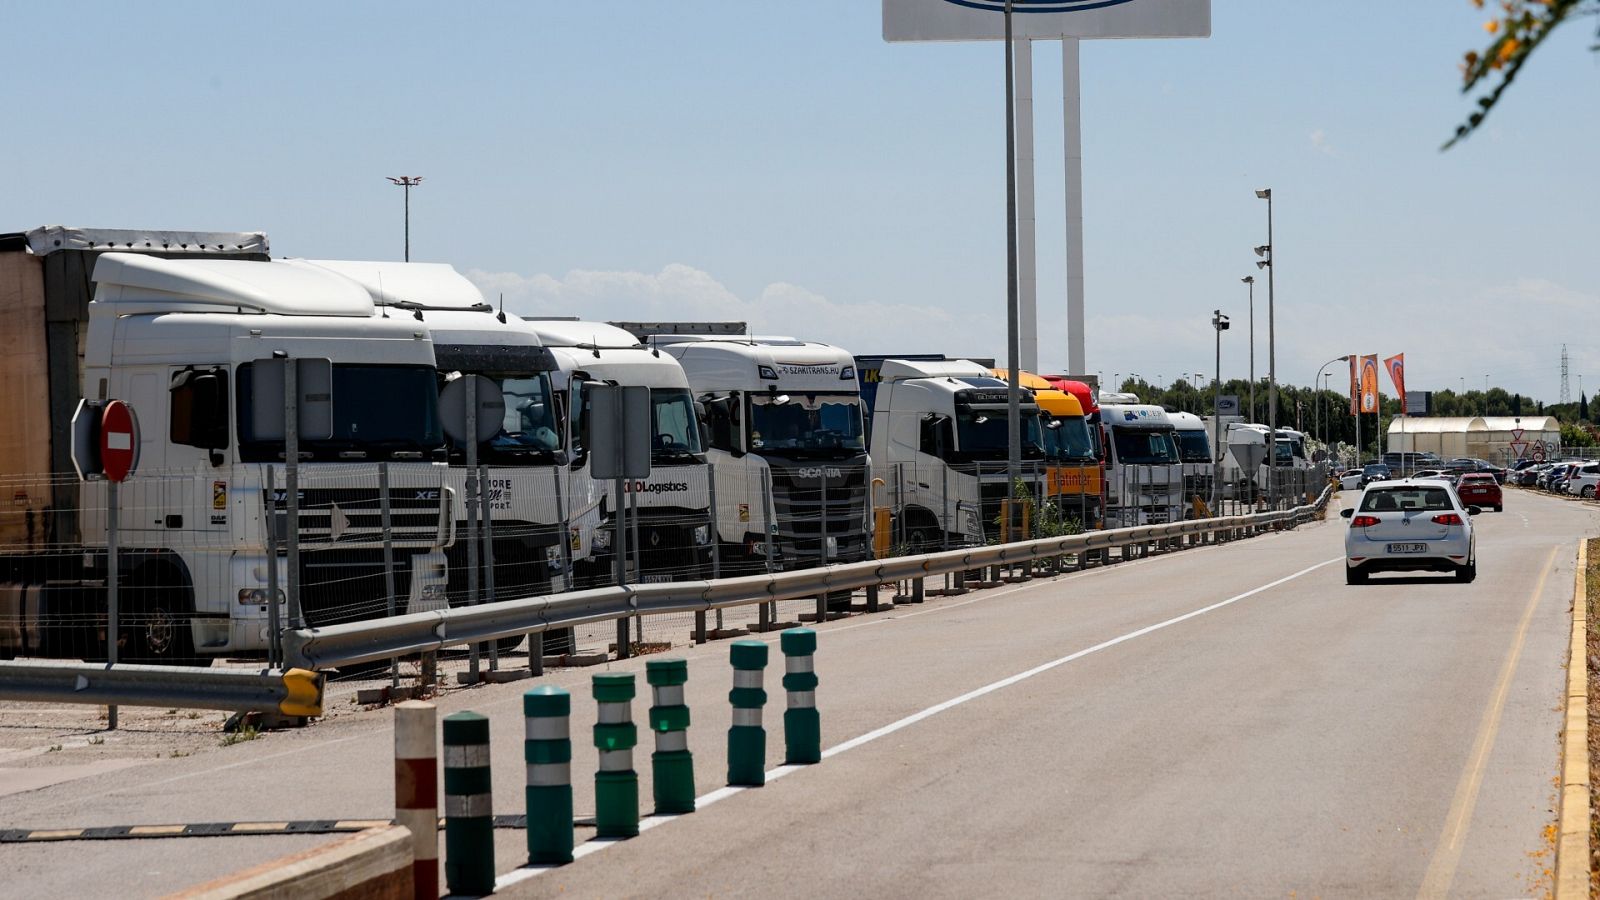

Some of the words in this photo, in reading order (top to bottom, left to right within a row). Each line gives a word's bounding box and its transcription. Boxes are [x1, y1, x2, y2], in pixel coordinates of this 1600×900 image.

[789, 365, 839, 375] SZAKITRANS.HU
[415, 490, 439, 500] XF
[1392, 543, 1410, 552] 5511
[1412, 543, 1425, 552] JPX
